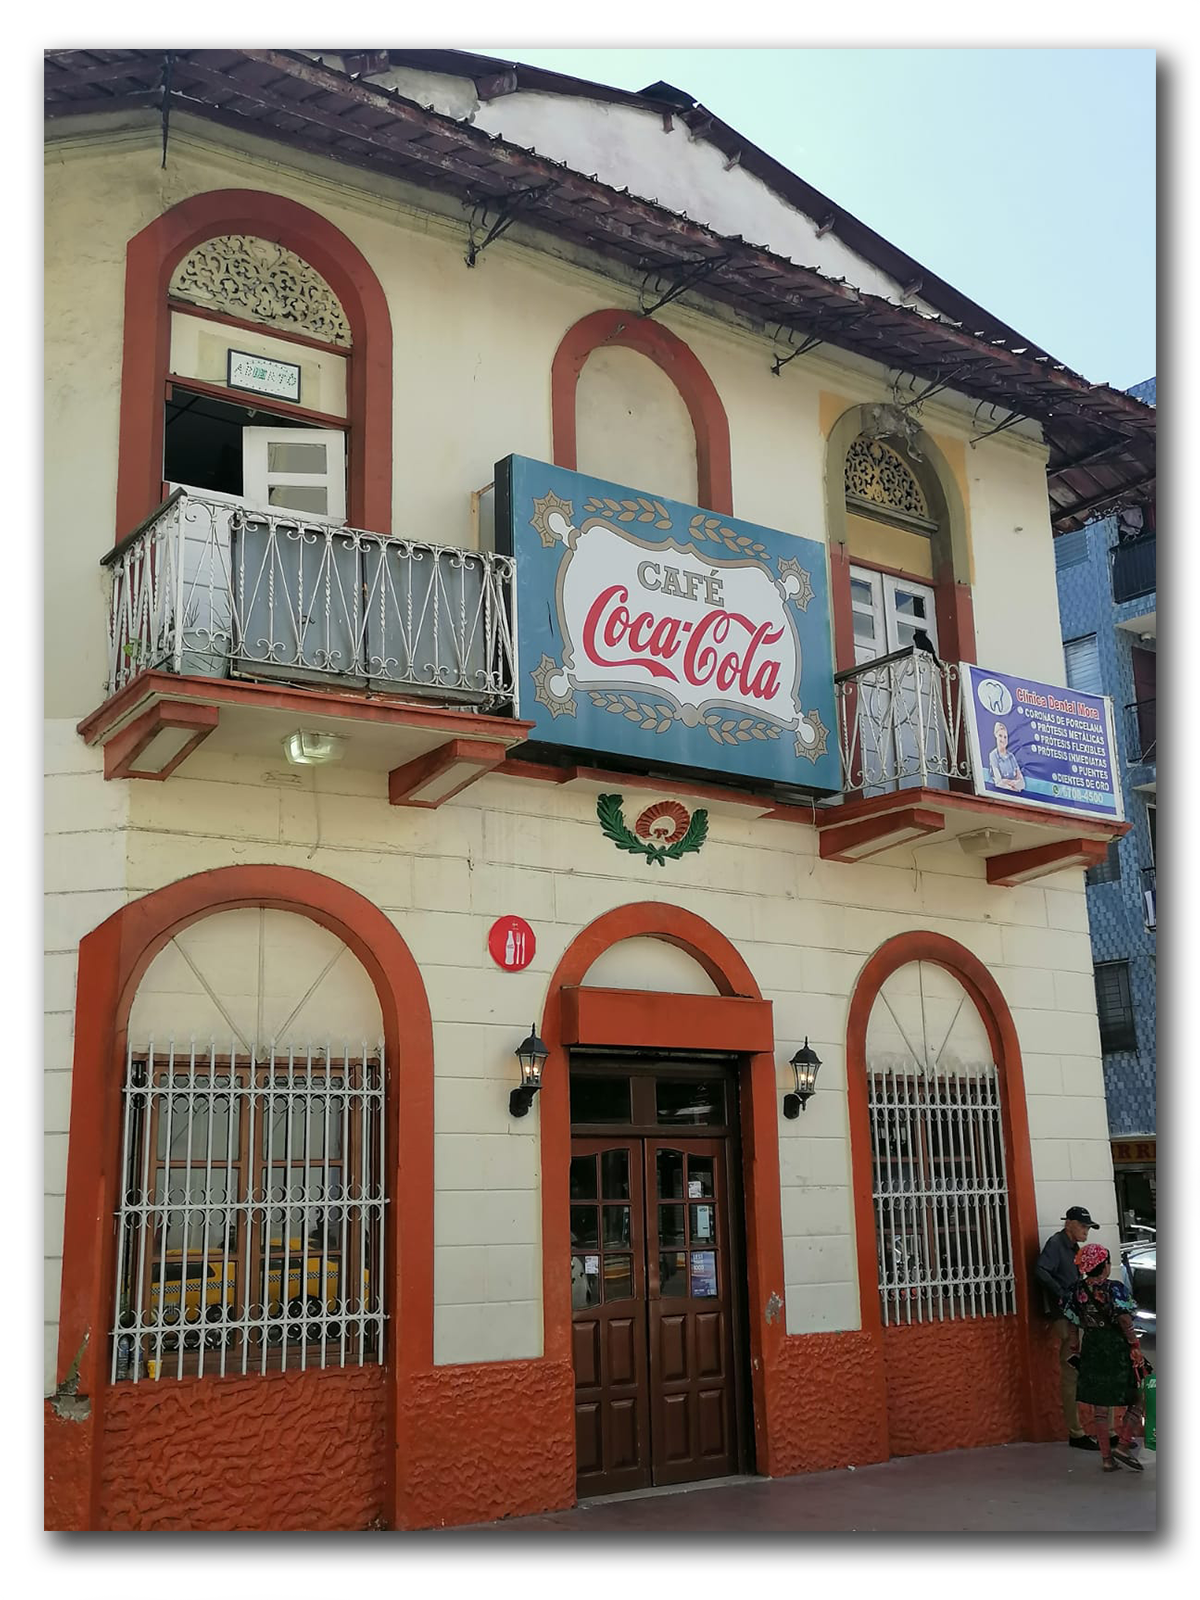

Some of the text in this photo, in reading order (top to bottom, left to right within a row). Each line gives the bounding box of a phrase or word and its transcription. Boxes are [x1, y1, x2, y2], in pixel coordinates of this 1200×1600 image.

[637, 560, 725, 608] CAFÉ
[582, 584, 785, 701] Coca-Cola
[1047, 695, 1077, 715] Dental
[1077, 701, 1099, 720] Mora
[1025, 708, 1104, 735] CORONAS DE PORCELANA
[1068, 752, 1107, 768] INMEDIATAS
[1072, 742, 1106, 757] FLEXIBLES
[1057, 773, 1110, 792] DIENTES DE ORO
[1078, 766, 1109, 780] PUENTES
